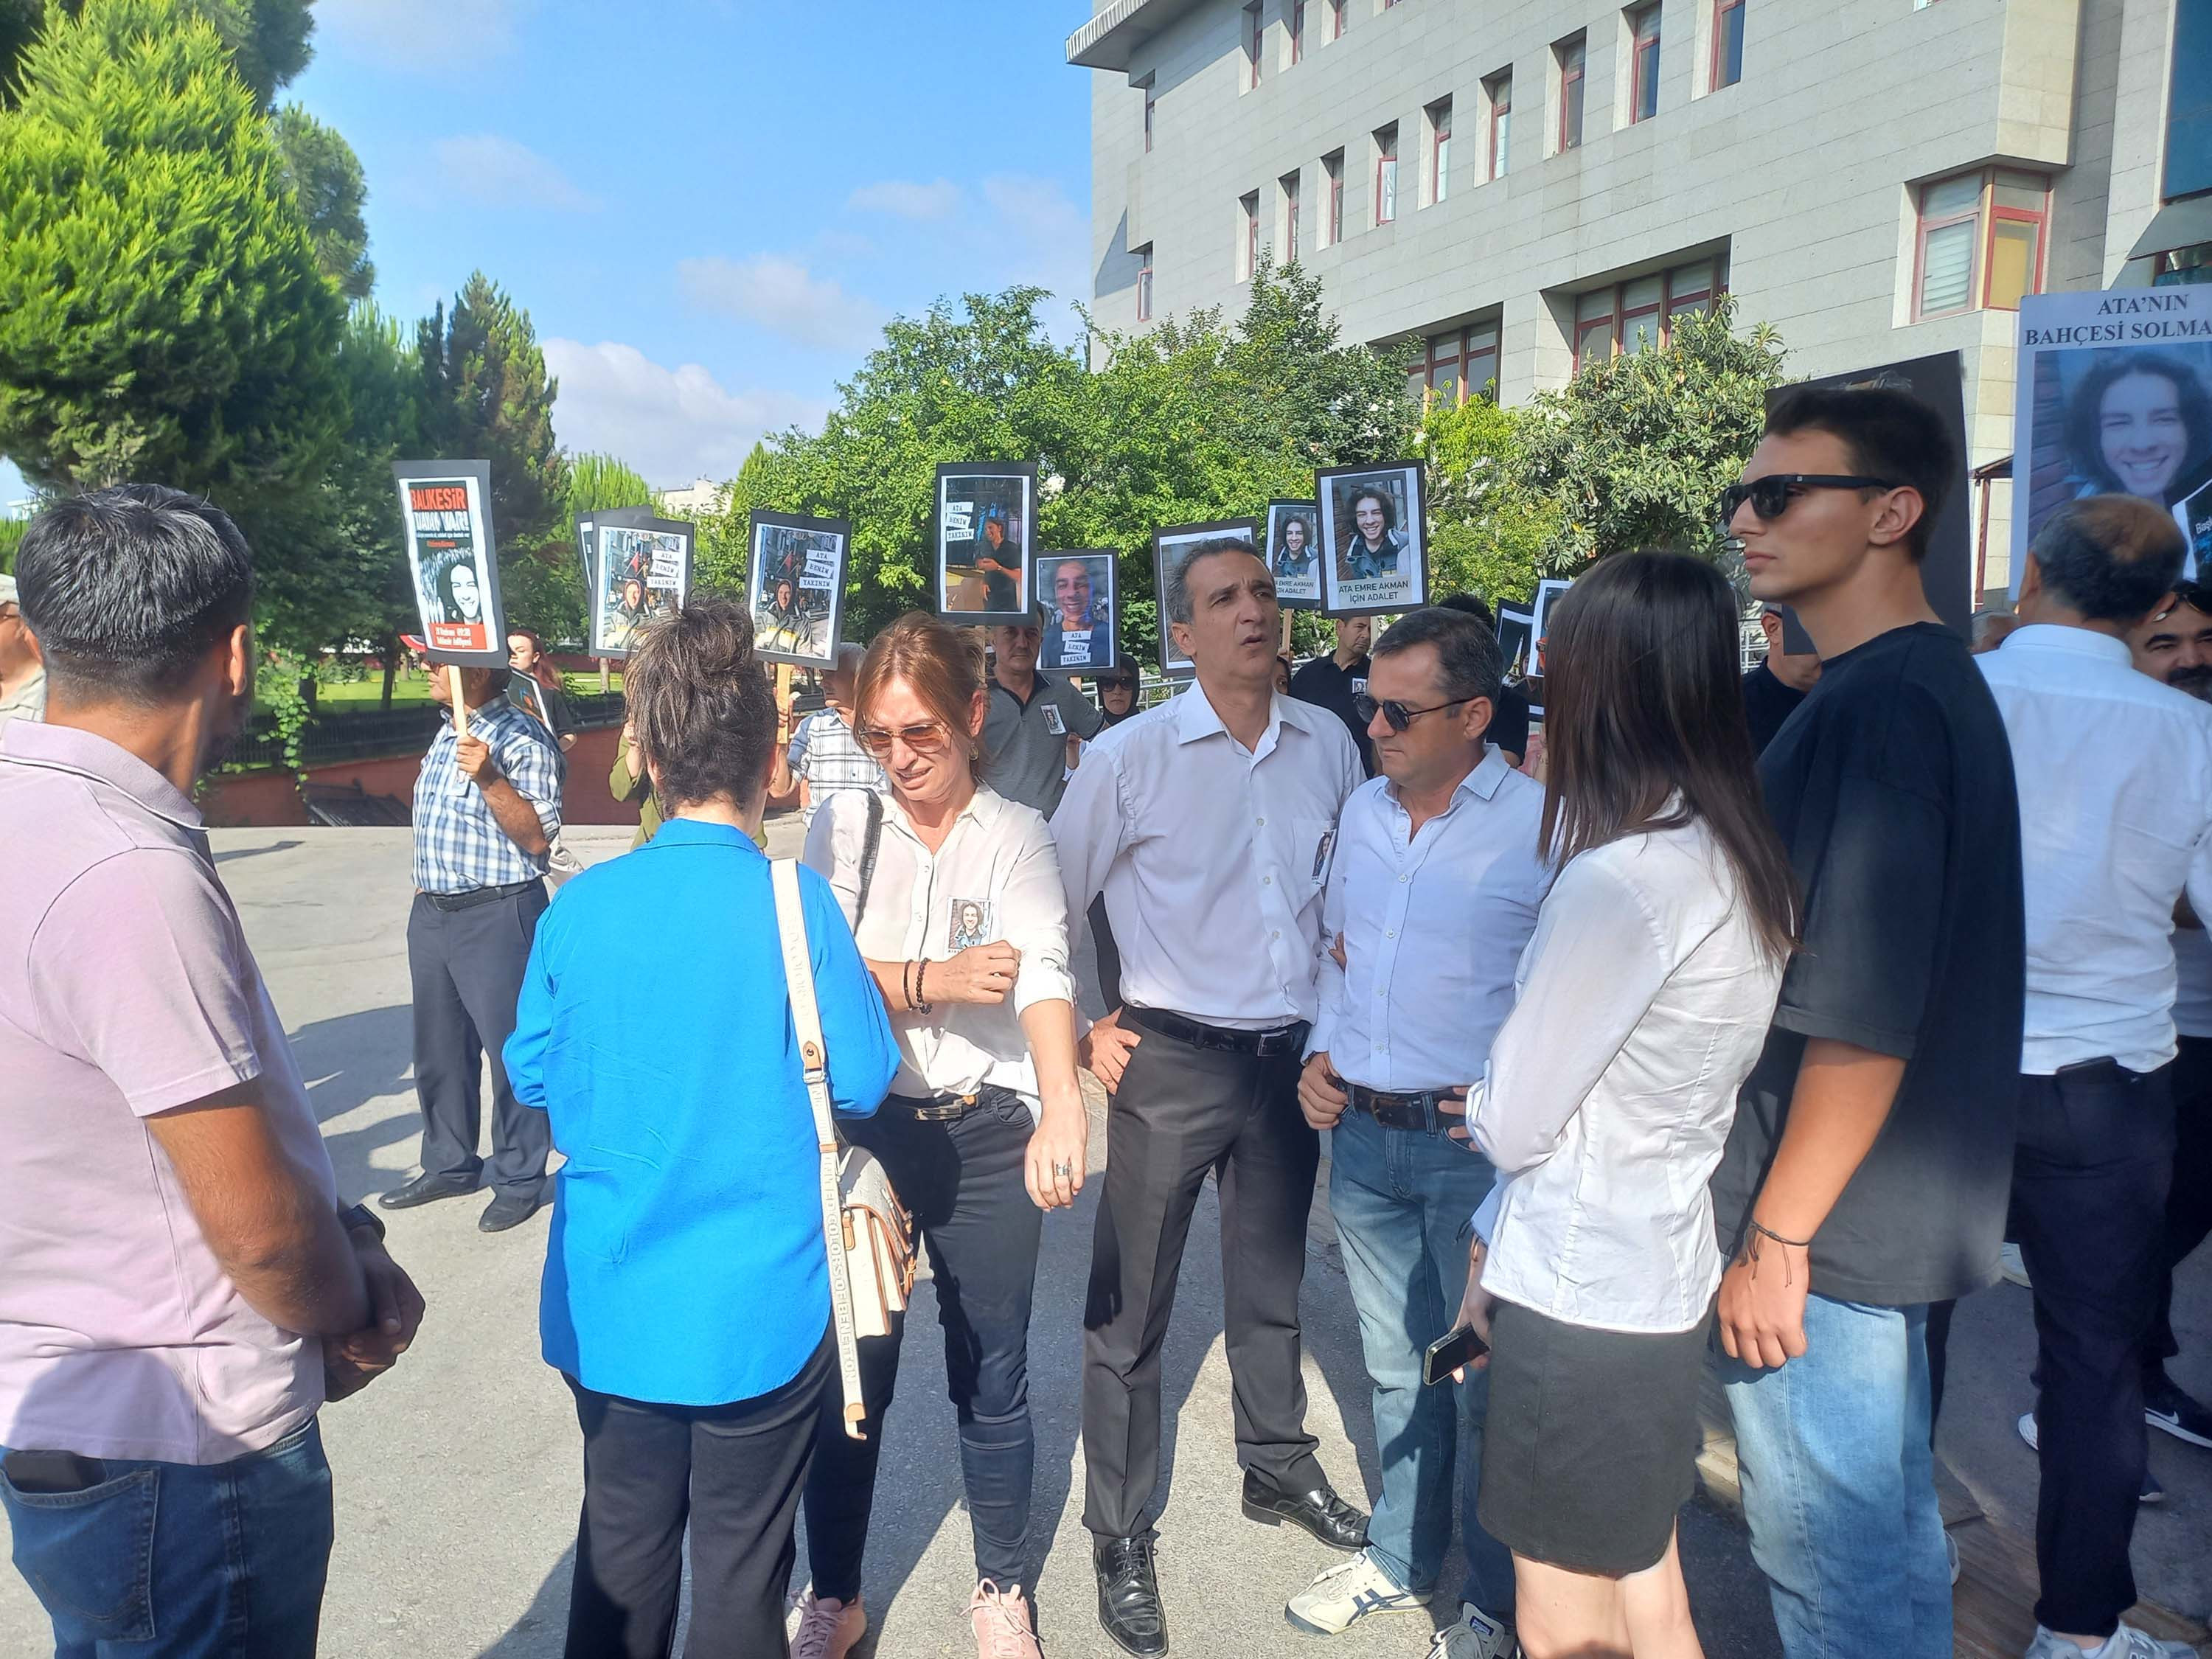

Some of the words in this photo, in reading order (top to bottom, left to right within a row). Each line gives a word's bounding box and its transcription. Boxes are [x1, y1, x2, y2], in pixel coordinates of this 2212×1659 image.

[2097, 294, 2189, 315] ATA'NIN
[2024, 321, 2124, 346] BAHÇESİ
[1338, 585, 1353, 593] ATA
[1354, 583, 1377, 592] EMRE
[1379, 580, 1408, 590] AKMAN
[1349, 593, 1366, 604] İÇİN
[1367, 591, 1399, 602] ADALET
[827, 1214, 844, 1276] COLORS
[834, 1279, 847, 1300] OF
[837, 1301, 857, 1382] BENETTON
